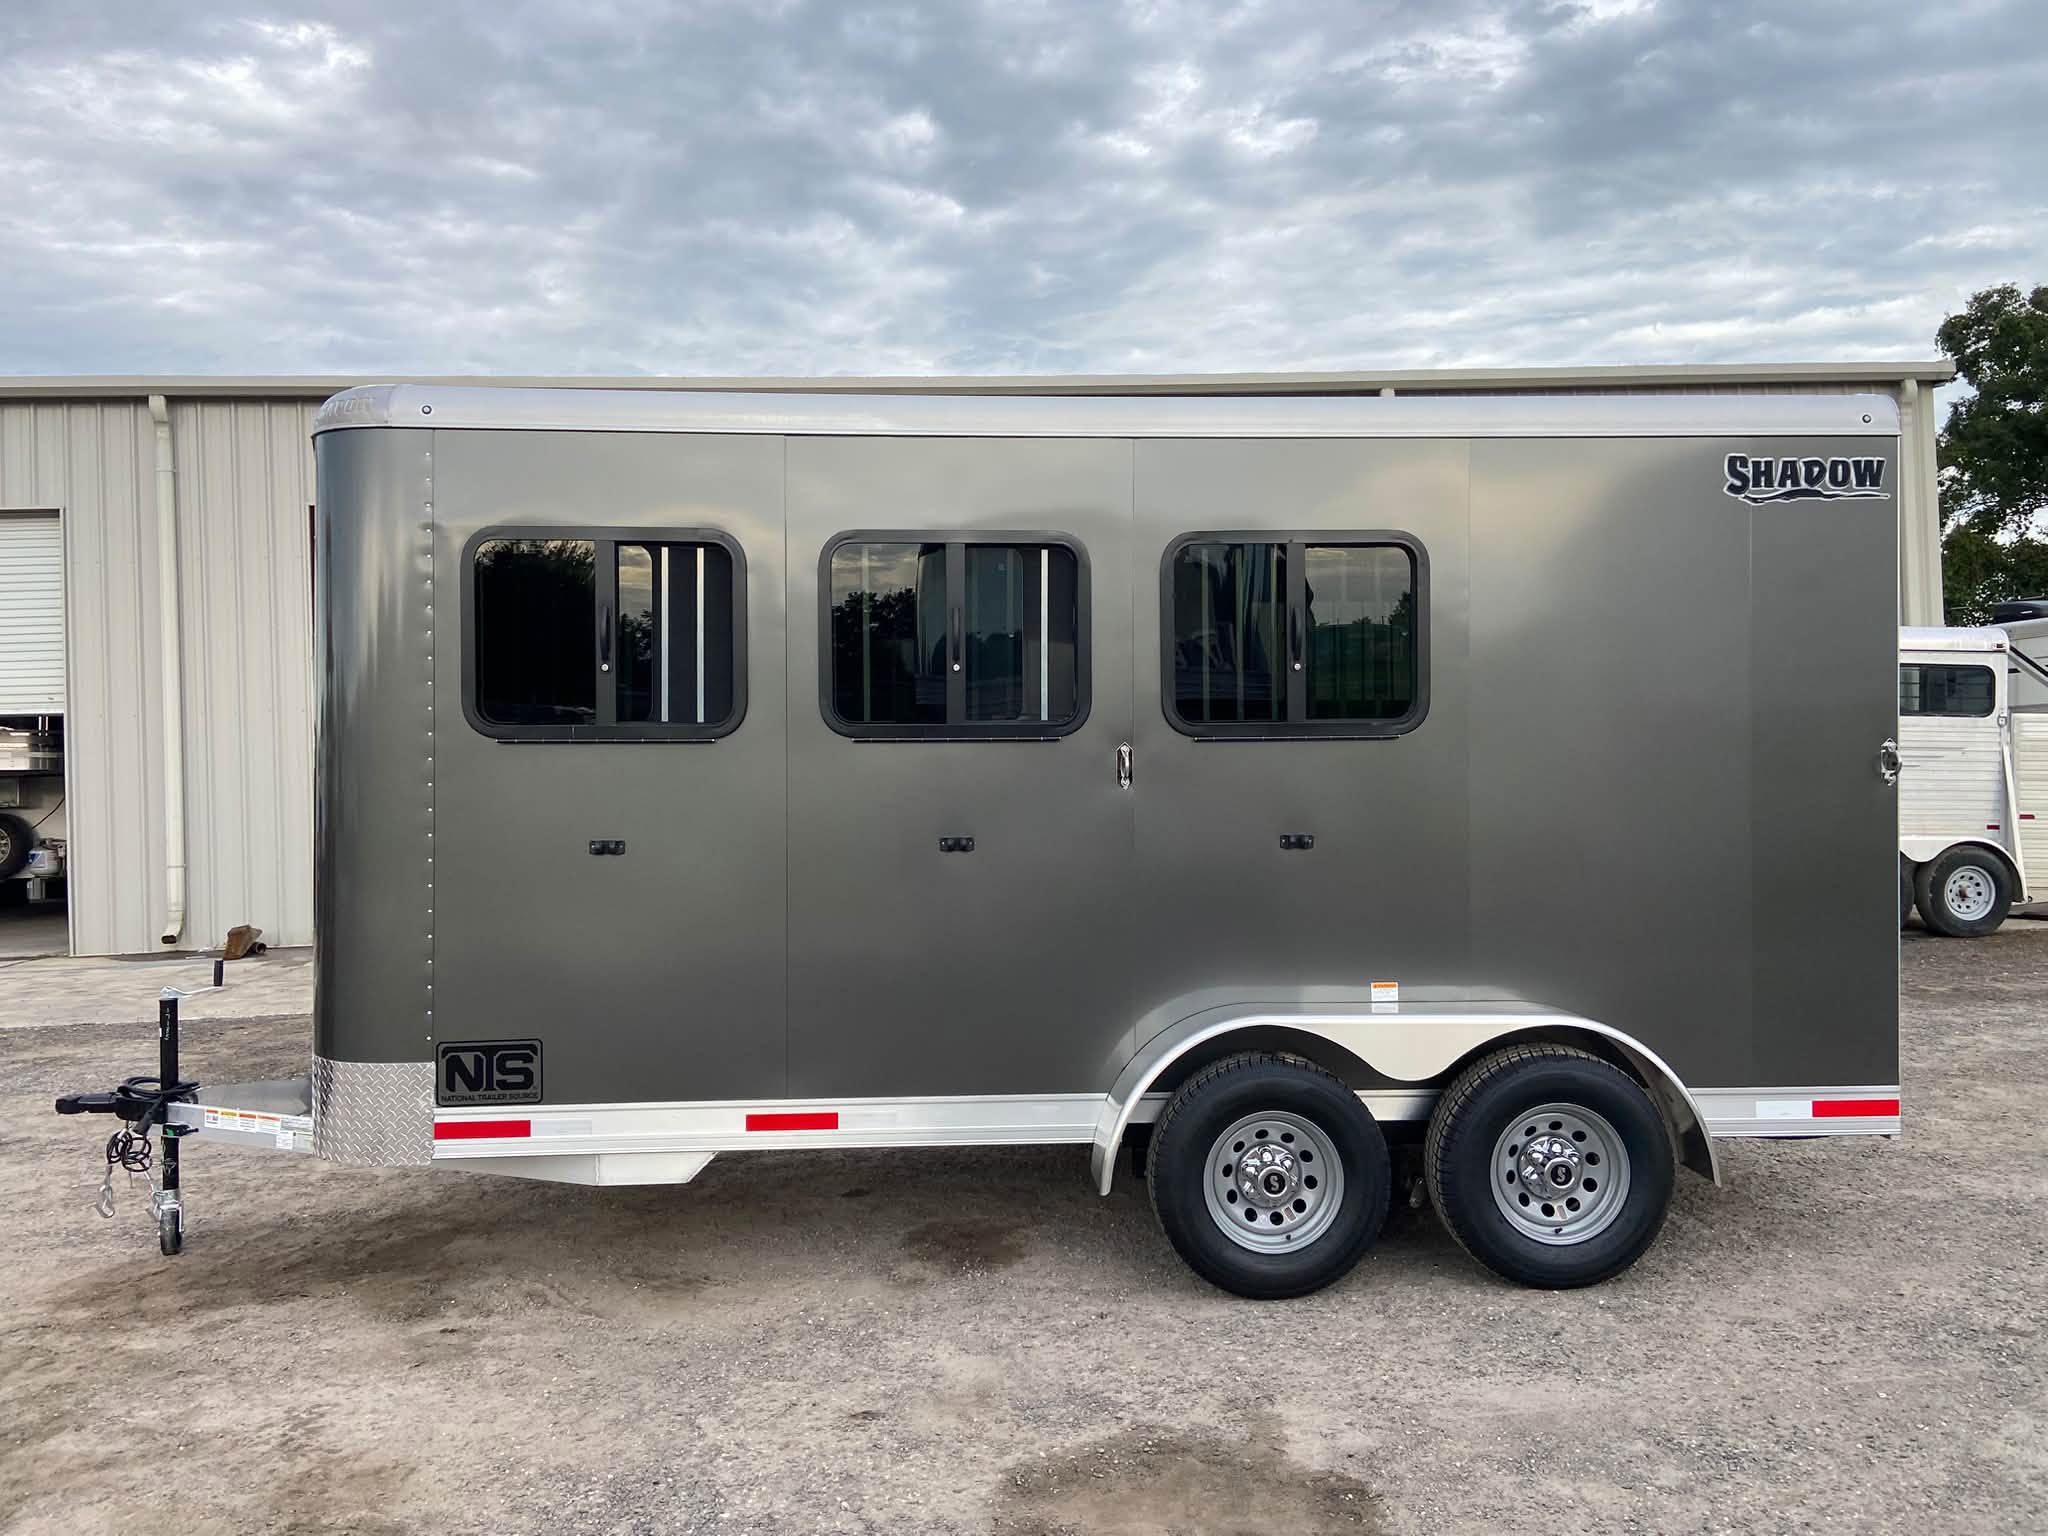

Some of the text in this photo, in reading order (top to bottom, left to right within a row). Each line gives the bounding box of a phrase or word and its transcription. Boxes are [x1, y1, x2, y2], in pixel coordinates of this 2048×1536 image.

[1723, 453, 1887, 497] SHADOW
[441, 1044, 538, 1092] NTS
[441, 1095, 476, 1103] NATIONAL
[477, 1093, 508, 1101] TRAILER
